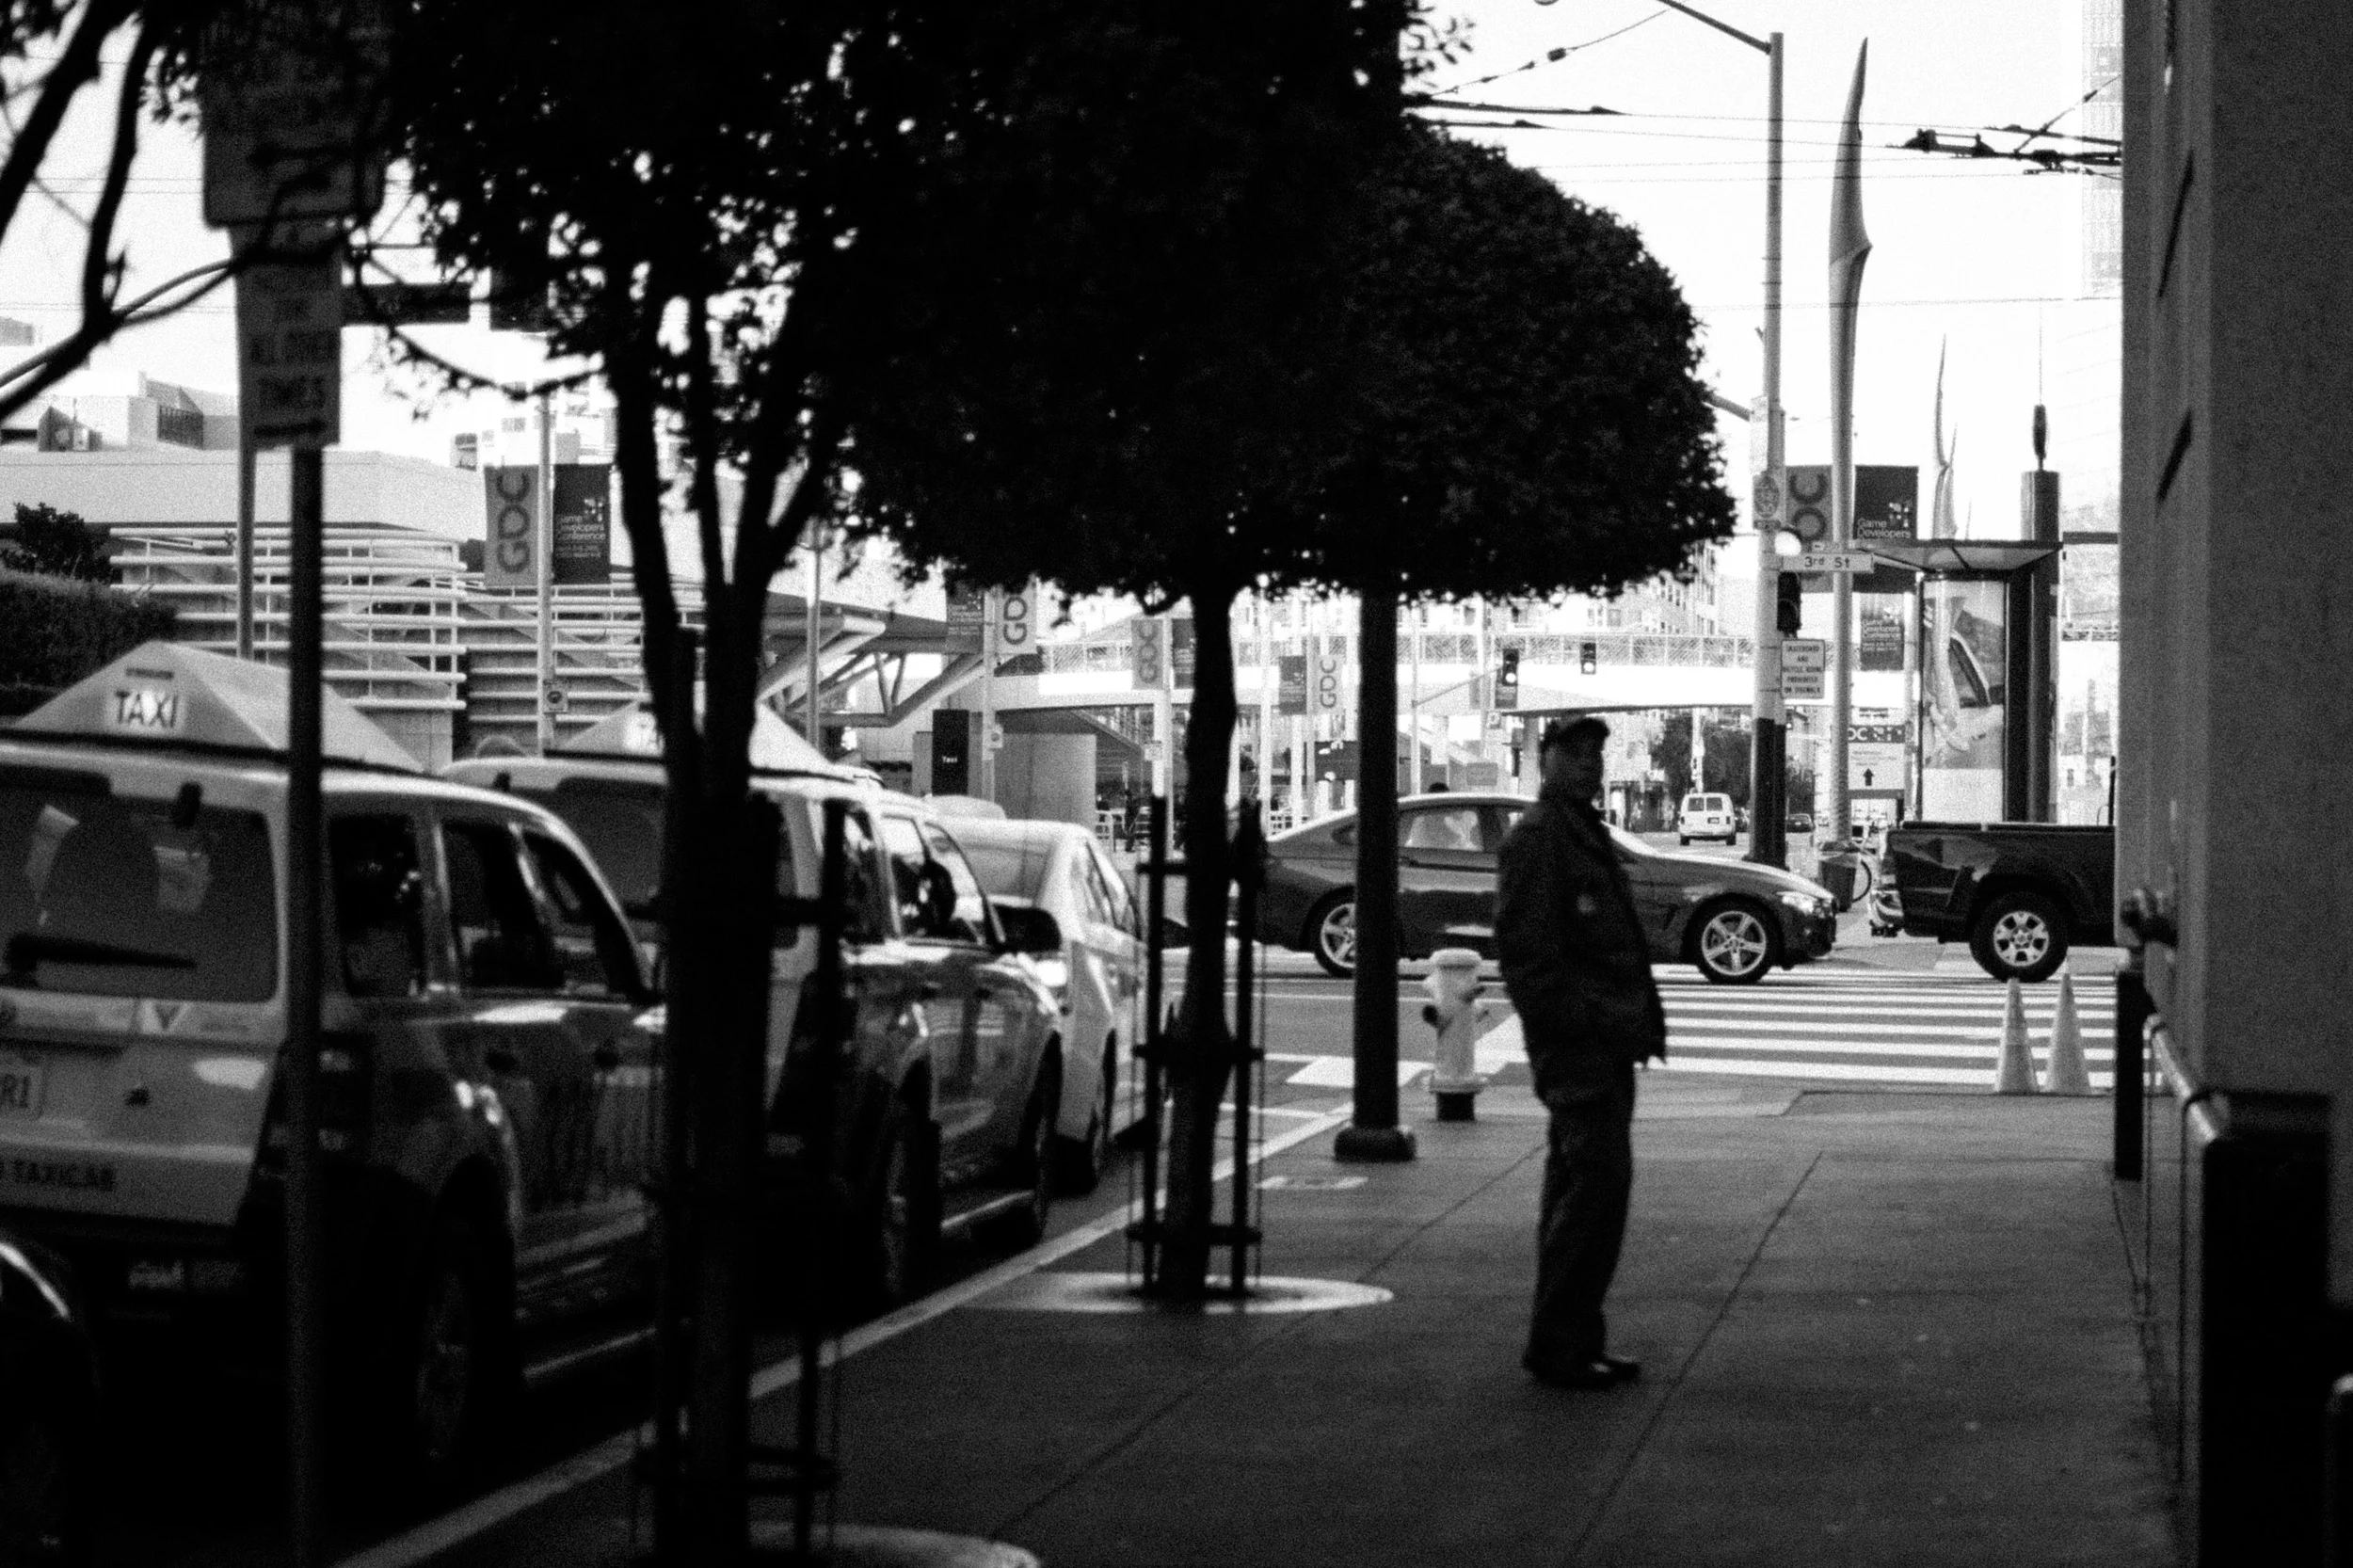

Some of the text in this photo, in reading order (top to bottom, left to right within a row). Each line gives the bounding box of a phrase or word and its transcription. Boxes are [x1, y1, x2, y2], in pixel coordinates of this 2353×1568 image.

[496, 472, 530, 574] GDC
[1857, 518, 1887, 528] Game
[1804, 556, 1849, 568] 3rd St
[1003, 595, 1027, 645] GD
[1320, 660, 1337, 708] GDC
[115, 689, 179, 728] TAXI
